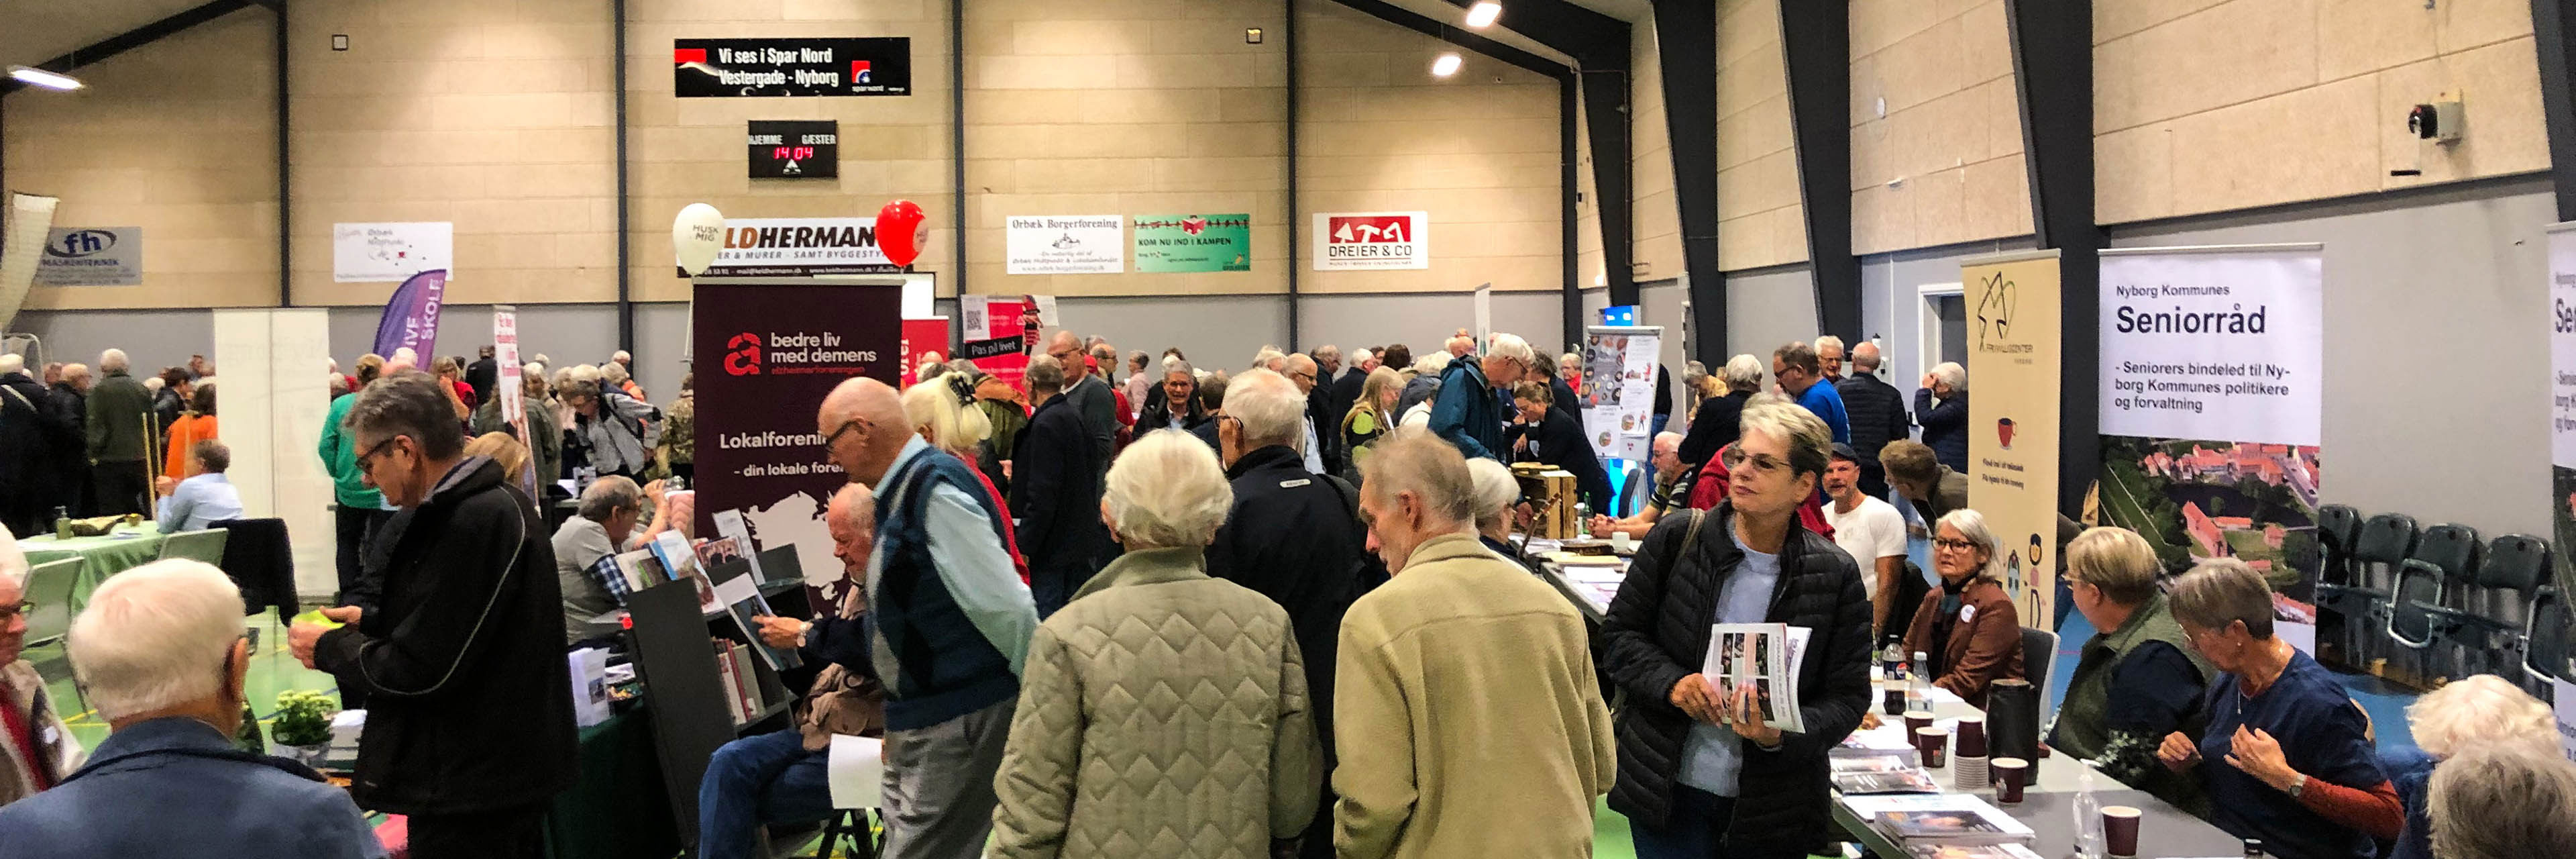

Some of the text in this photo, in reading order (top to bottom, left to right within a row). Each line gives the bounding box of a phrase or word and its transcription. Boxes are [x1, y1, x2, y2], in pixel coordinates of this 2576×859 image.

[718, 48, 833, 66] Vi ses i Spar Nord
[719, 70, 786, 87] Vestergade
[795, 69, 839, 87] Nyborg
[692, 224, 719, 234] HUSK
[1012, 219, 1118, 230] Ørbæk Borgerforening
[64, 231, 101, 254] fh
[695, 232, 715, 242] MIG
[1197, 238, 1231, 246] KAMPEN
[745, 251, 782, 259] MURER
[794, 251, 822, 259] SAMT
[1329, 246, 1411, 256] DREIER & CO
[2116, 285, 2231, 299] Nyborg Kommunes
[2116, 303, 2265, 334] Seniorråd
[771, 332, 841, 347] bedre liv
[971, 345, 987, 355] Pas
[999, 341, 1016, 351] livet
[771, 348, 877, 363] med demens
[2123, 361, 2184, 374] Seniorers
[2188, 362, 2245, 376] bindeled
[2249, 364, 2261, 376] til
[2265, 364, 2290, 380] Ny-
[2115, 378, 2289, 396] borg Kommunes politikere
[2114, 396, 2203, 413] og forvaltning
[743, 464, 765, 476] din
[767, 462, 808, 475] lokale
